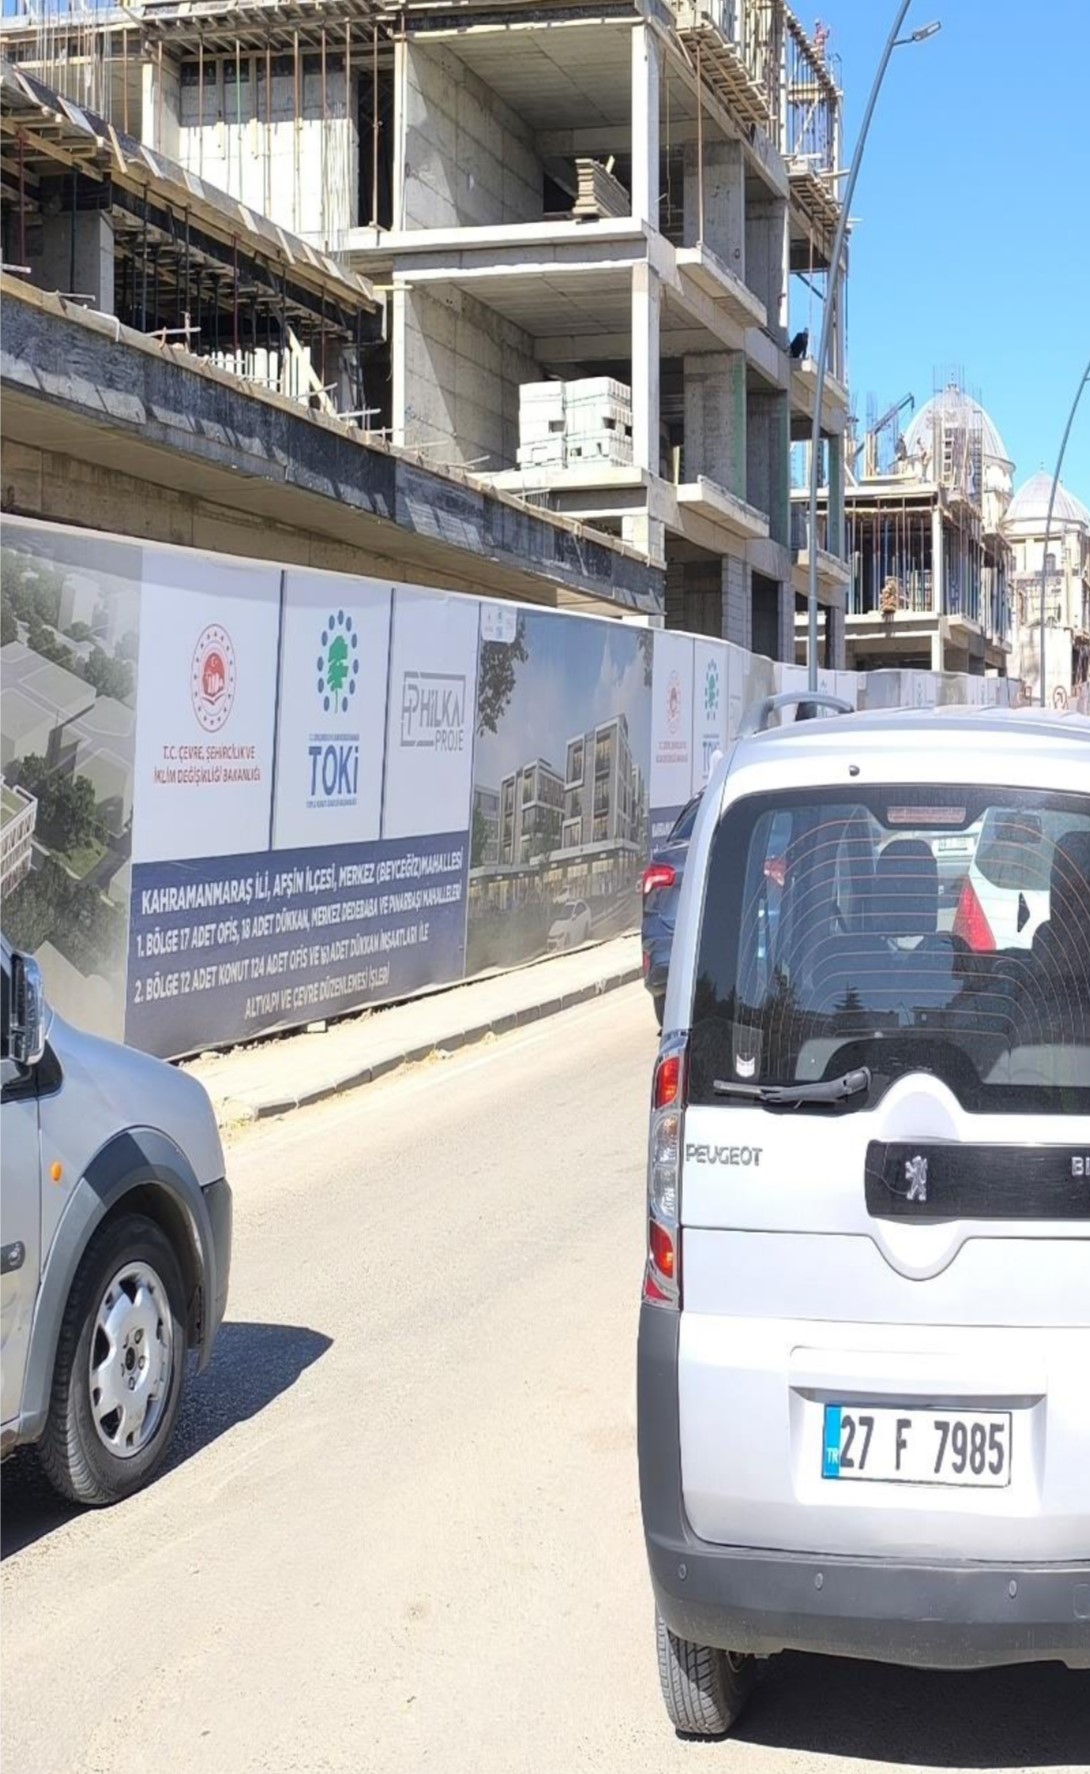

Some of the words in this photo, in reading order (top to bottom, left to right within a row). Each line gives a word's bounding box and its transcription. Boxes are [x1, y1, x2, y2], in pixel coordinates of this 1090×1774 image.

[163, 745, 177, 760] T.C.
[434, 729, 464, 751] PROJE
[141, 877, 253, 915] KAHRAMANMARAŞ
[273, 866, 304, 898] AFŞİN
[338, 862, 376, 888] MERKEZ
[136, 934, 144, 957] 1.
[146, 926, 179, 957] BÖLGE
[180, 927, 190, 950] 17
[191, 923, 217, 949] ADET
[251, 913, 275, 938] ADET
[311, 902, 341, 927] MERKEZ
[379, 895, 388, 915] VE
[134, 979, 144, 1004] 2.
[146, 971, 179, 1001] BÖLGE
[180, 971, 191, 994] 12
[191, 965, 217, 992] ADET
[218, 958, 249, 986] KONUT
[250, 955, 265, 978] 124
[265, 950, 288, 975] ADET
[289, 944, 307, 970] OFİS
[309, 944, 319, 966] VE
[328, 936, 350, 962] ADET
[244, 989, 279, 1019] ALTYAPI
[280, 987, 292, 1010] VE
[686, 1143, 763, 1167] PEUGEOT
[826, 1447, 838, 1465] TR
[840, 1414, 875, 1471] 27
[895, 1418, 912, 1471] F
[934, 1420, 1005, 1475] 7985
